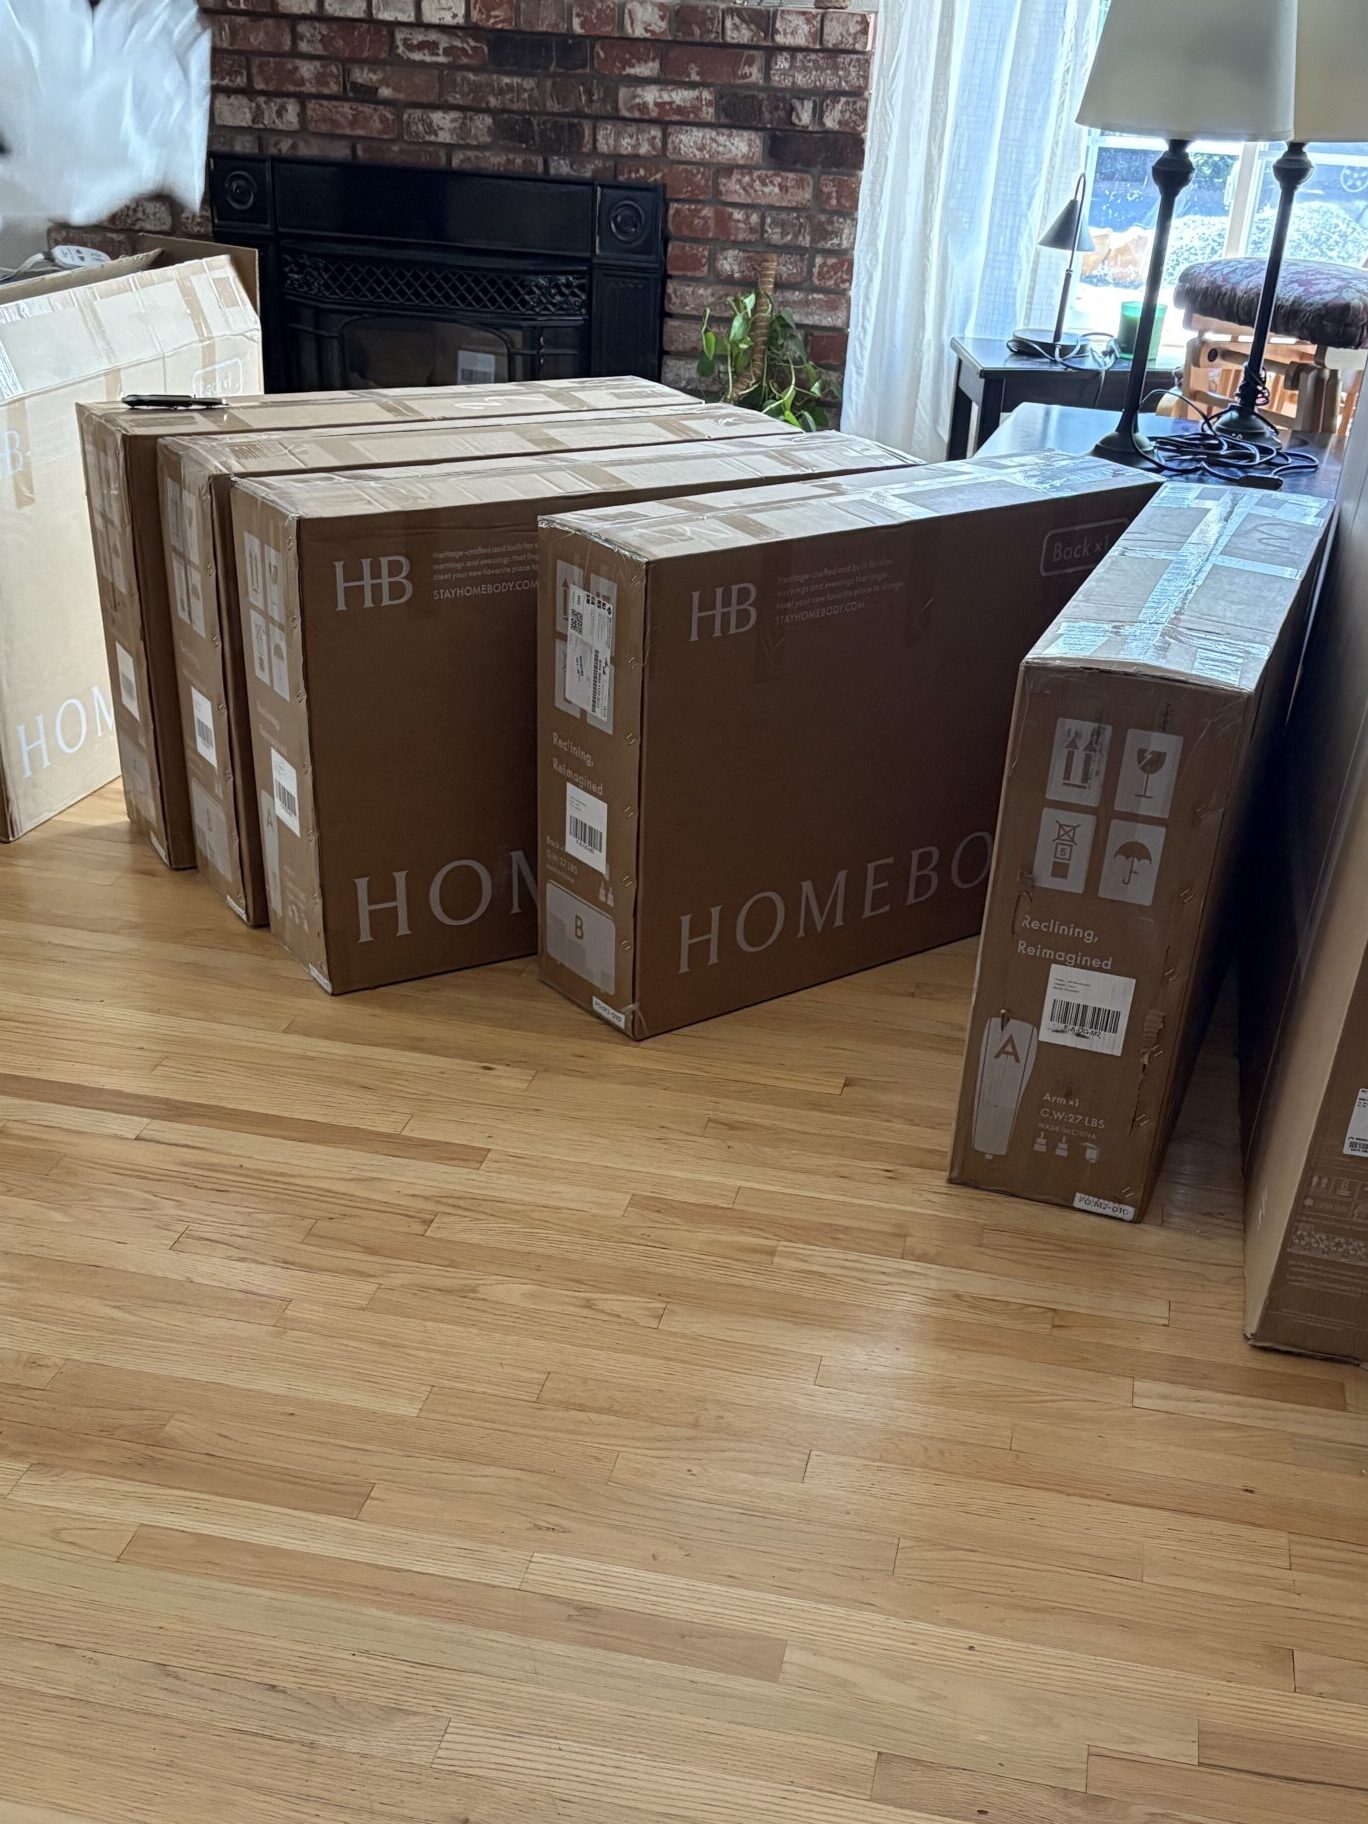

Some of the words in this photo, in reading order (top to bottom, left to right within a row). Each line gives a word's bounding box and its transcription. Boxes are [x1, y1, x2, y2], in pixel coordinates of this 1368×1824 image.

[1052, 537, 1090, 562] Back
[333, 555, 413, 611] HB
[433, 580, 538, 600] STAYHOMEBODY.COM
[689, 582, 757, 642] HB
[775, 599, 865, 626] STAYHOMEBODY.COM
[552, 731, 594, 767] Reclining,
[552, 757, 603, 796] Reimagined
[1058, 847, 1067, 857] 5
[574, 914, 585, 940] B
[1021, 914, 1099, 944] Reclining,
[1017, 940, 1112, 970] Reimagined
[993, 1034, 1021, 1063] A
[1042, 1092, 1066, 1105] Arm
[1084, 1116, 1105, 1129] LBS
